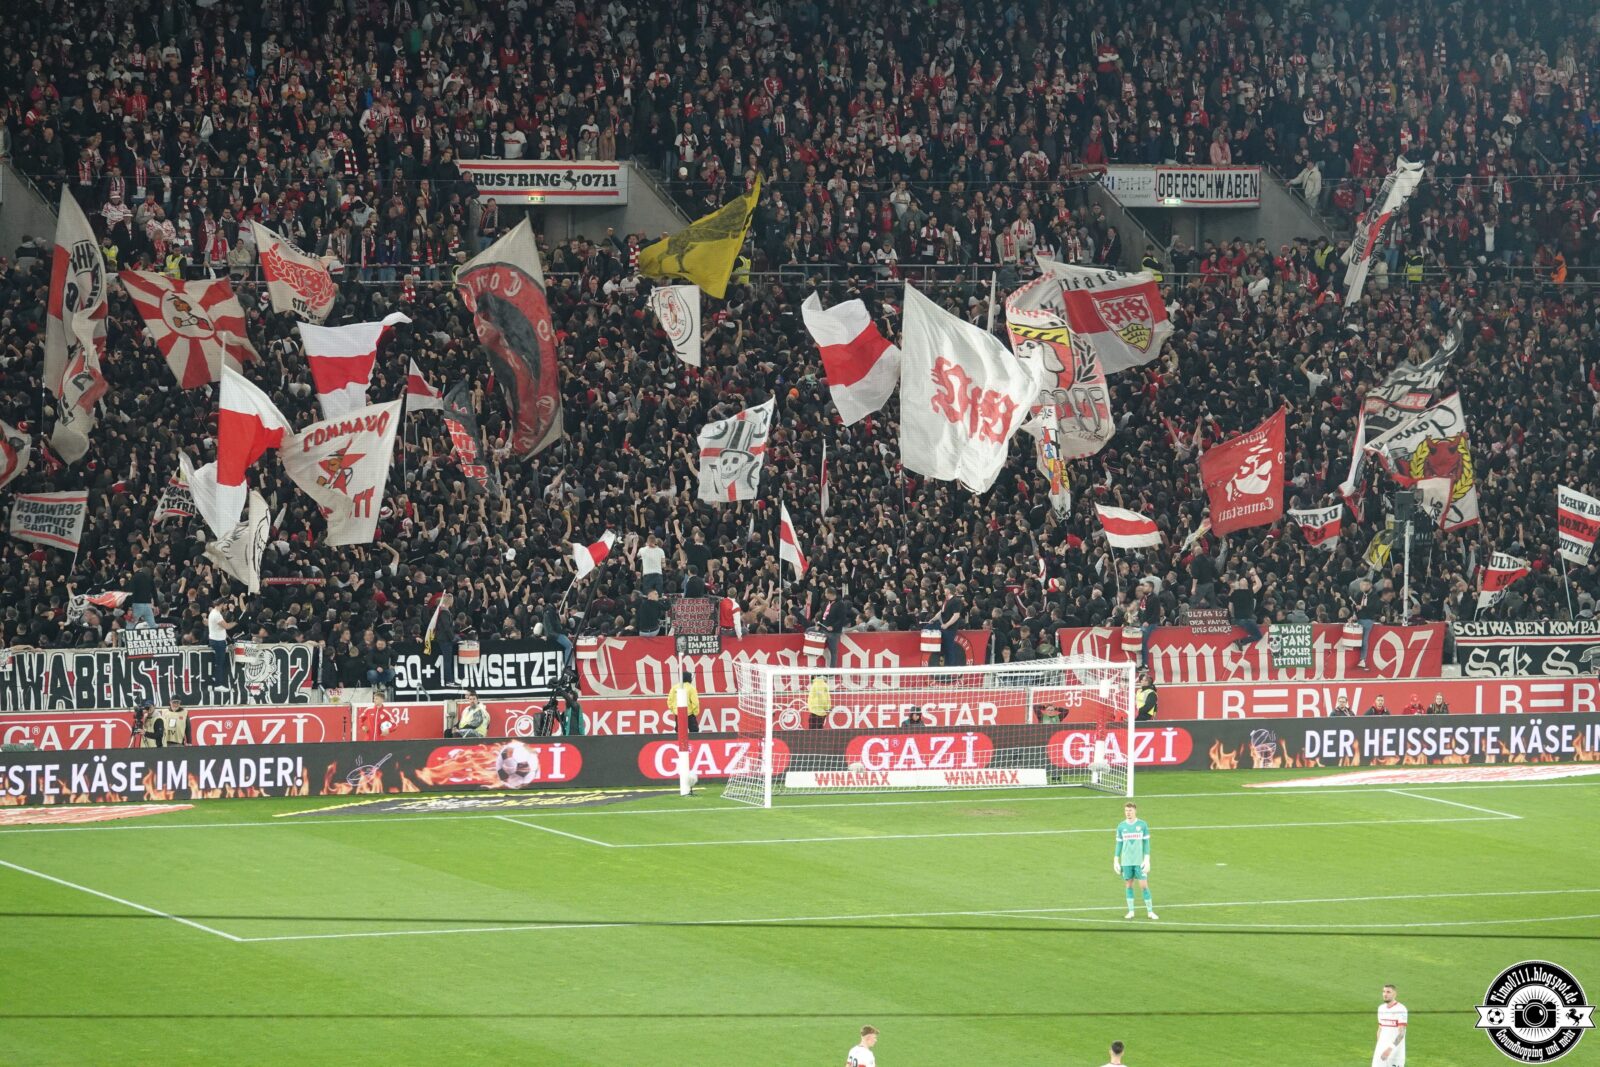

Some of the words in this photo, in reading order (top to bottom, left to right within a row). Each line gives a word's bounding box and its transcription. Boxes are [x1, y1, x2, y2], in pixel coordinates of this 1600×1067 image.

[474, 172, 561, 187] RUSTRING
[581, 173, 617, 187] 0711
[1158, 173, 1258, 198] OBERSCHWABEN
[125, 627, 175, 641] ULTRAS
[1281, 625, 1312, 634] MAGIC
[1453, 621, 1545, 636] SCHWABEN
[127, 638, 177, 649] BEDEUTET
[688, 641, 719, 649] IMMER
[1282, 635, 1311, 646] FANS
[127, 645, 179, 656] WIDERSTAND
[1283, 647, 1311, 656] POUR
[1372, 629, 1434, 681] 97
[268, 645, 312, 706] 02
[1064, 690, 1083, 708] 35
[392, 707, 410, 725] 34
[1304, 728, 1355, 759] DER
[1364, 725, 1500, 756] HEISSESTE
[1510, 718, 1576, 754] KÄSE
[1585, 723, 1600, 752] I
[71, 755, 146, 794] KÄSE
[157, 760, 188, 790] IM
[200, 756, 304, 788] KADER!
[815, 771, 891, 787] WINAMAX
[944, 769, 1020, 785] WINAMAX
